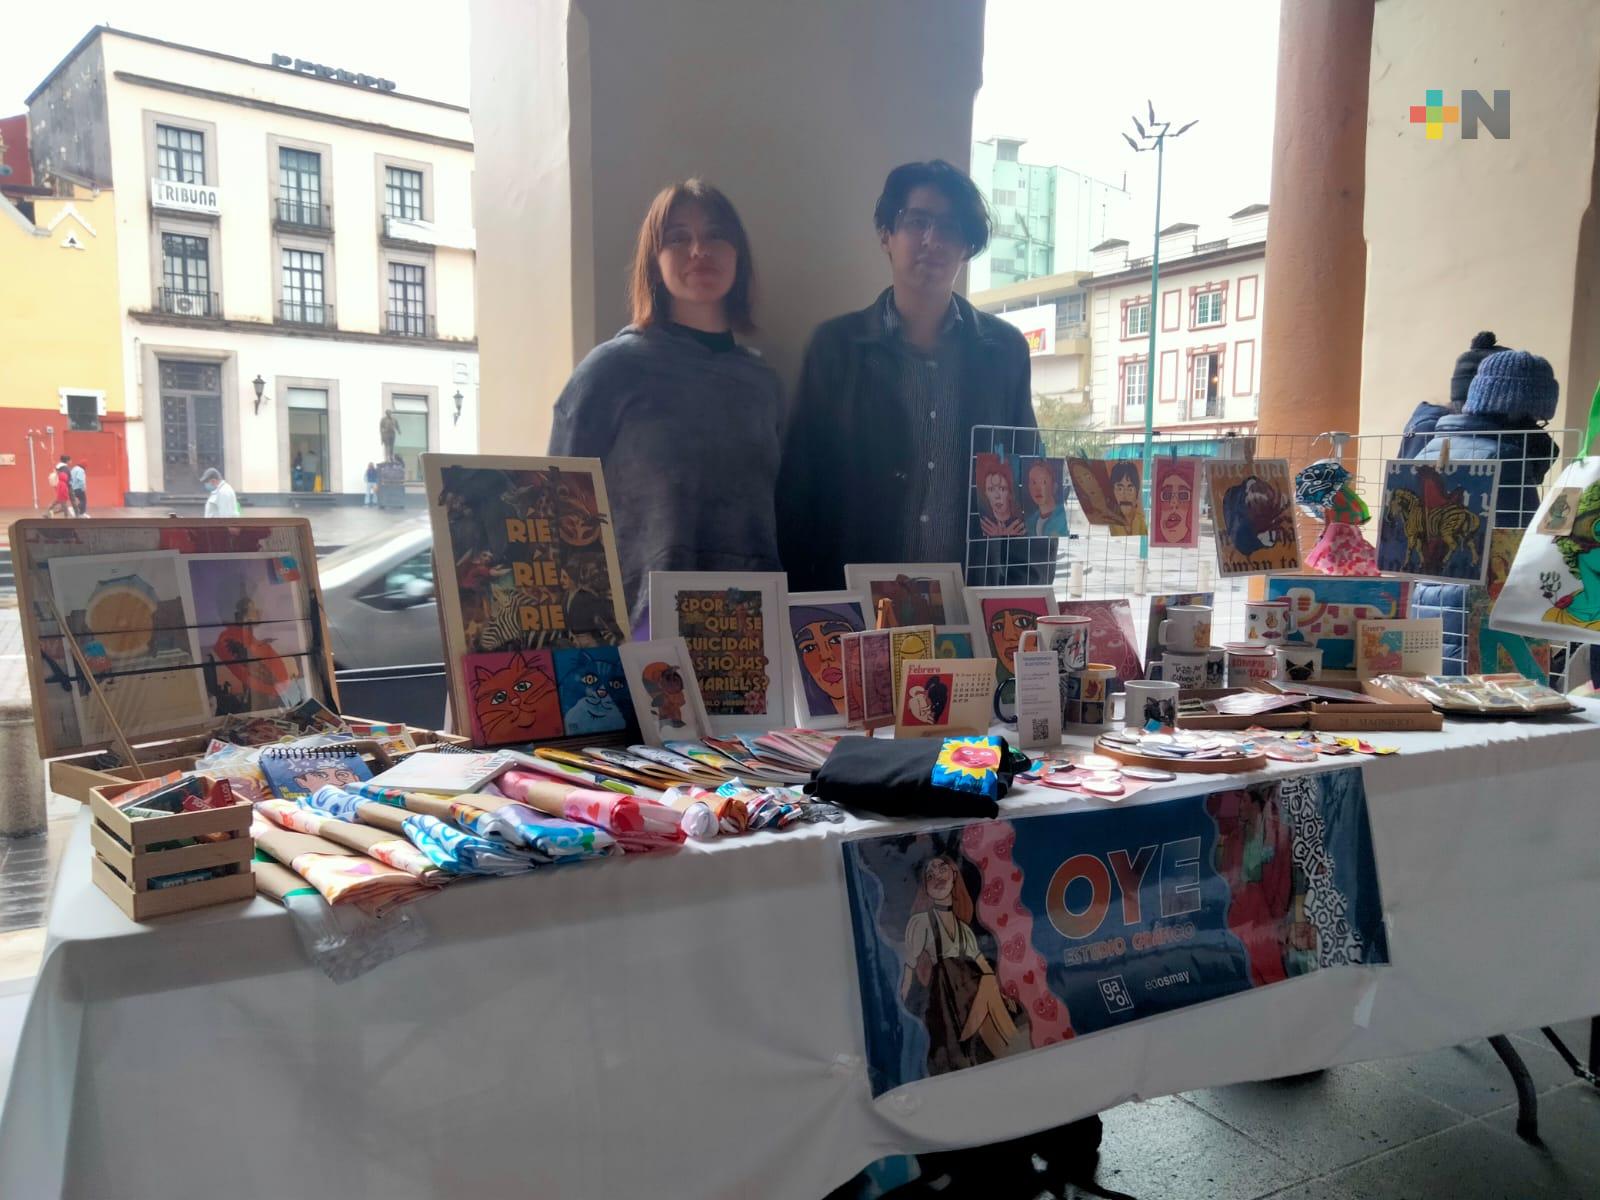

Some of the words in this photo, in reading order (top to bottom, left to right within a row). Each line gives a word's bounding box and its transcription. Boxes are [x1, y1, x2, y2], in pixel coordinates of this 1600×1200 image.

[157, 183, 217, 207] TRIBUNA
[708, 655, 764, 672] HOJAS
[908, 664, 941, 674] Febrero
[701, 675, 769, 691] ARILLAS?
[1045, 836, 1201, 940] OYE
[1064, 937, 1126, 967] ESTUDIO
